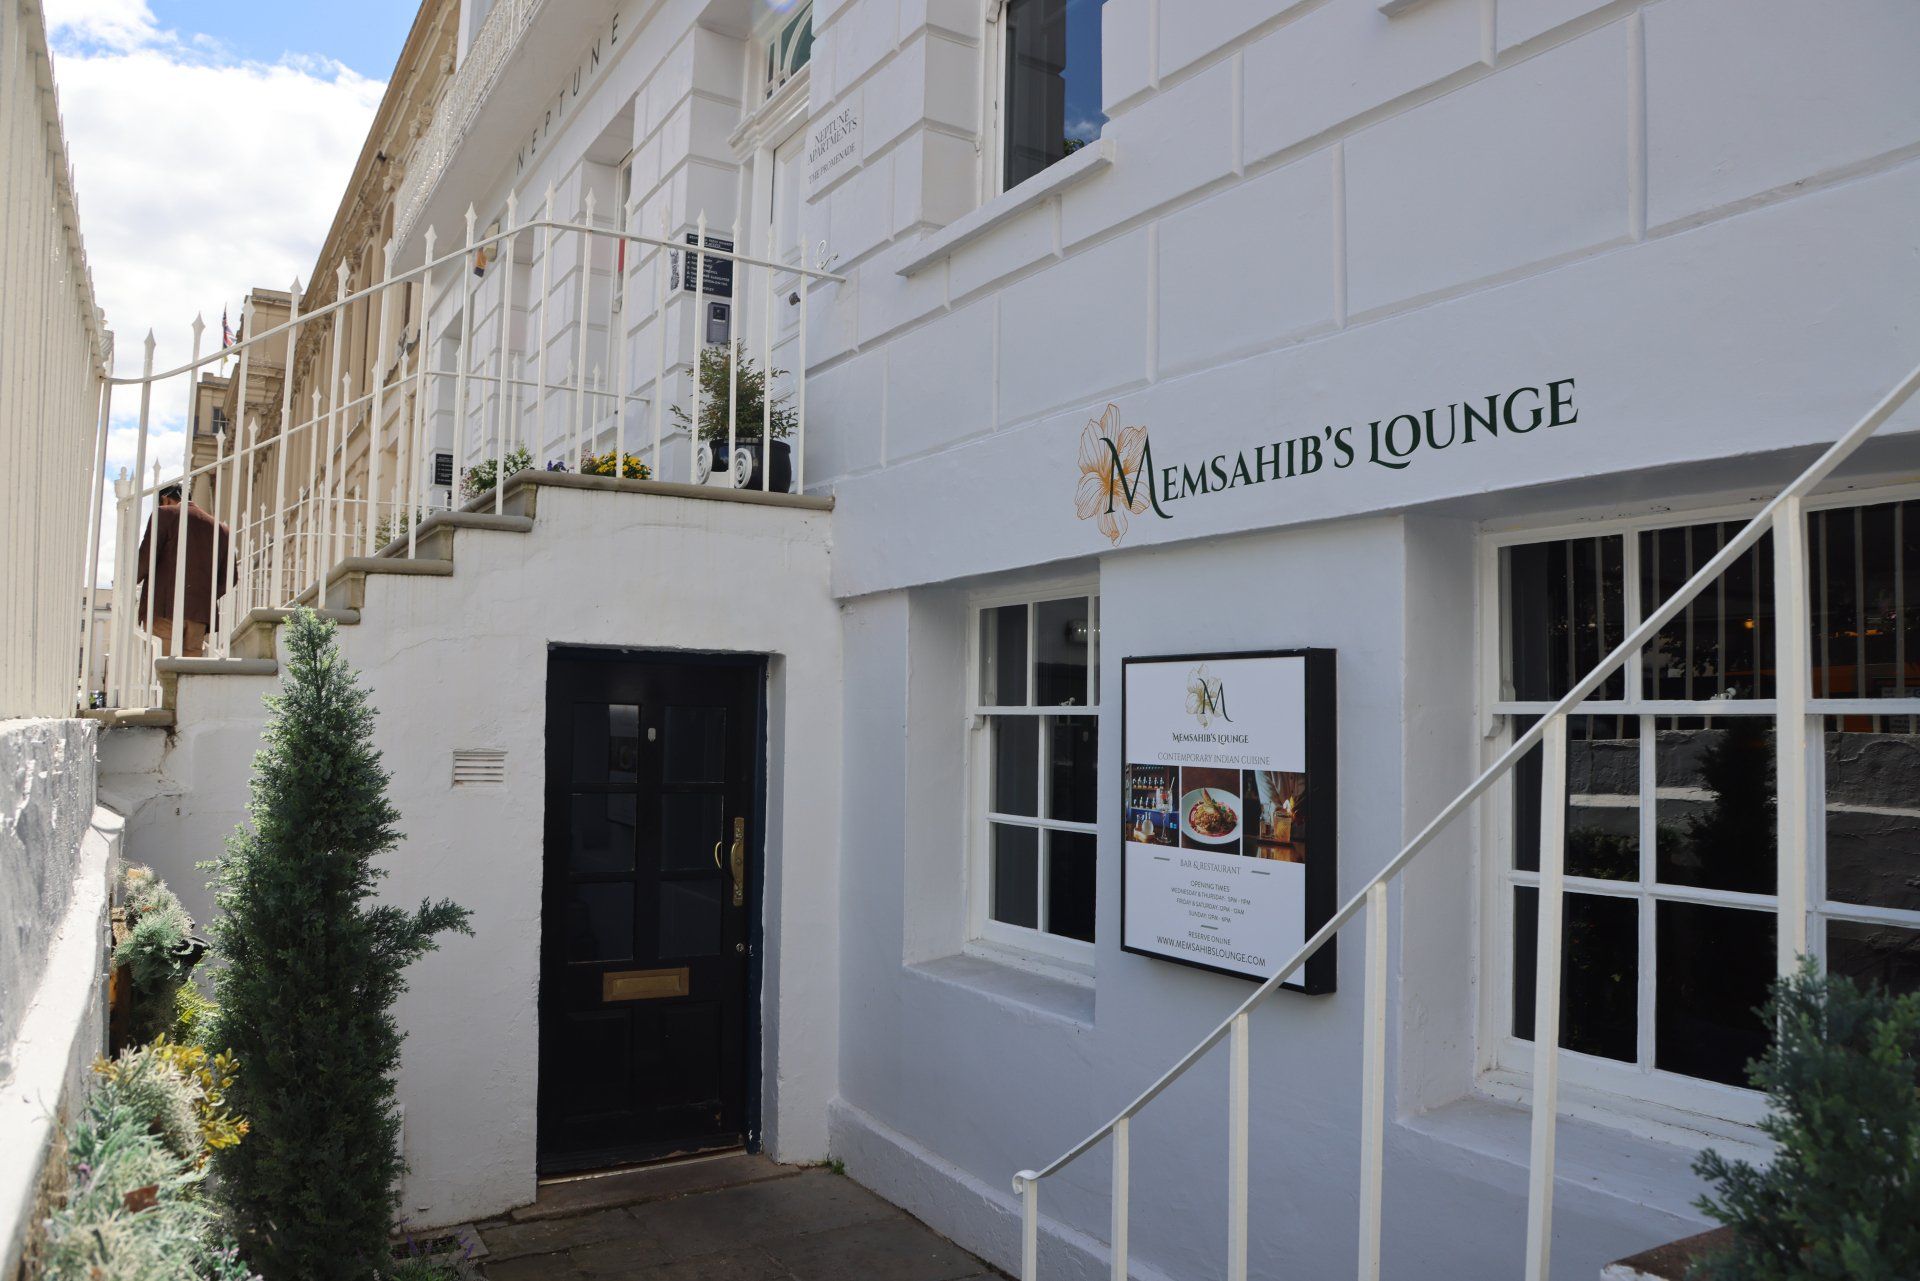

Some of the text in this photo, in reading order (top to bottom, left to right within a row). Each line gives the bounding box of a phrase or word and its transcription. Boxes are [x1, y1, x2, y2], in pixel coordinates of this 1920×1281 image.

[517, 12, 619, 176] NEPTUNE
[815, 108, 850, 143] NEPTUNE
[808, 117, 857, 166] APARTMENTS
[809, 142, 855, 184] THE PROMENADE
[1100, 377, 1579, 519] MEMSAHIB'S LOUNGE
[1172, 732, 1249, 745] MEMSAHIB'S LOUNGE
[1157, 752, 1271, 765] CONTEMPORARY INDIAN CUISINE
[1180, 859, 1241, 875] BAR & RESTAURANT
[1171, 887, 1197, 896] WEDNESDAY
[1190, 880, 1230, 892] OPENING TIMES
[1188, 930, 1231, 945] RESERVE ONLINE
[1156, 936, 1266, 967] WWW.MEMSAHIBSLOUNGE.COM
